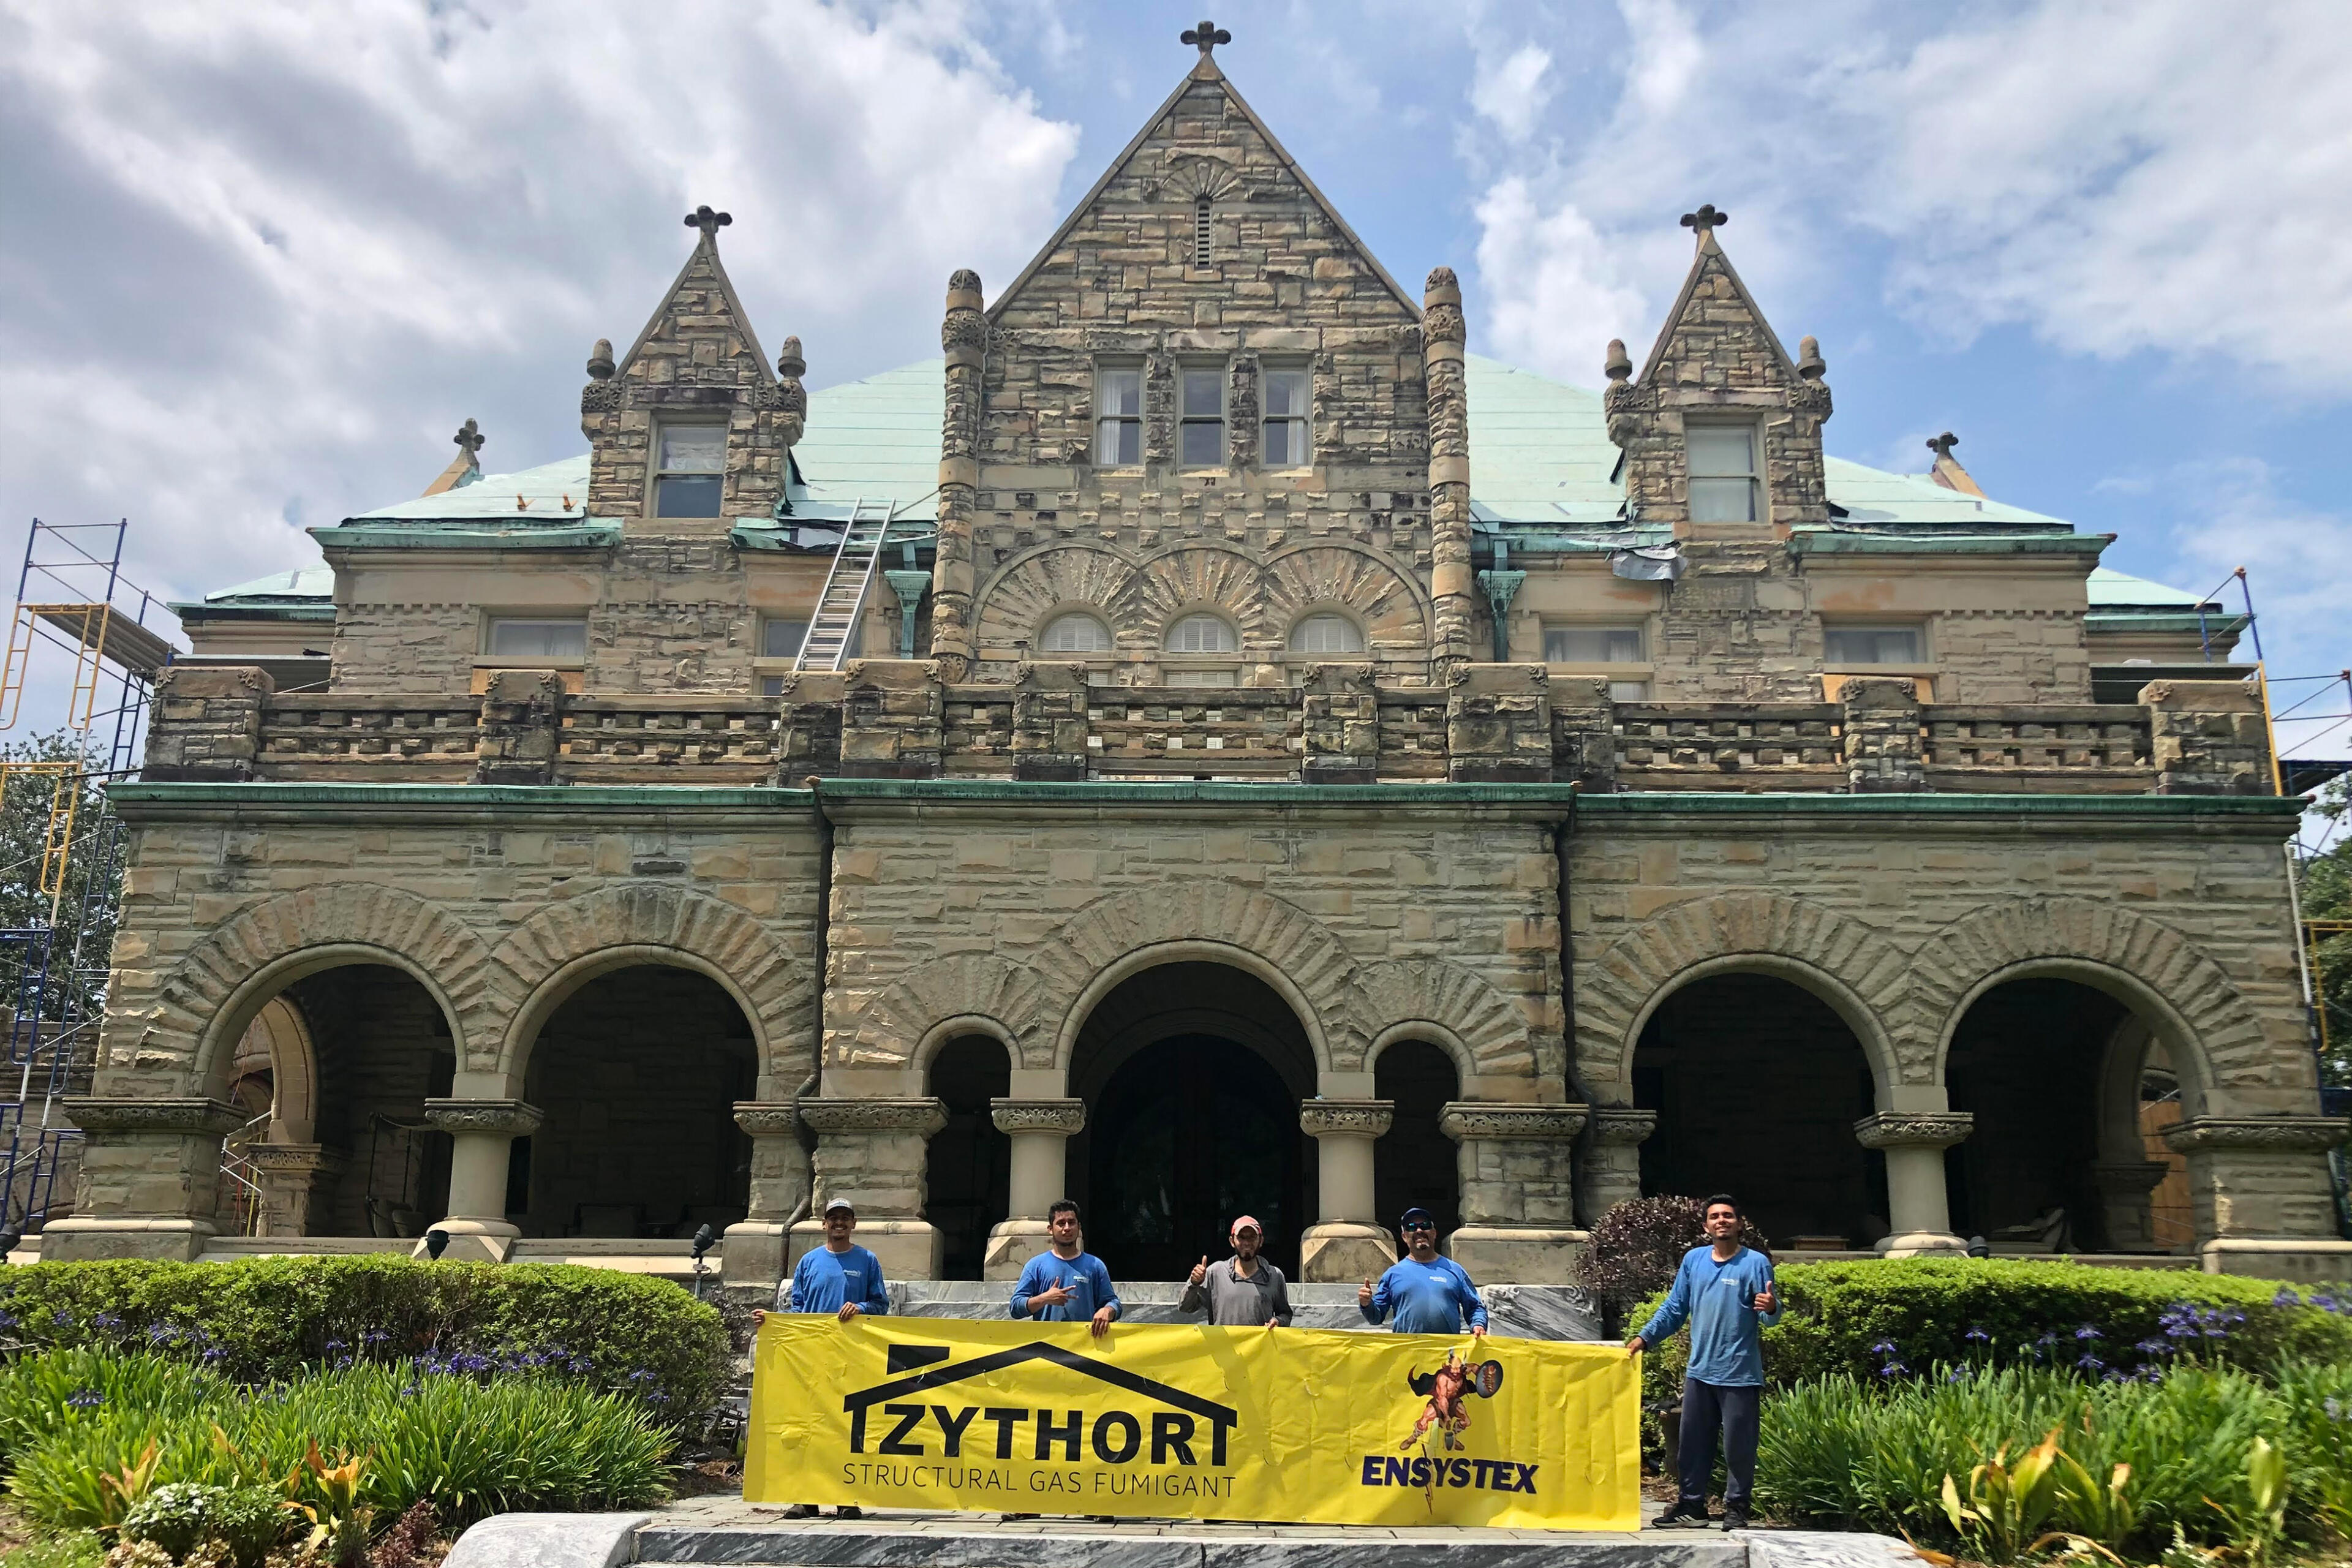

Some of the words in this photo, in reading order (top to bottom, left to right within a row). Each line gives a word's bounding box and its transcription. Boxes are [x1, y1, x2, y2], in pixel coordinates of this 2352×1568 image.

[878, 1403, 1198, 1466] ZYTHOR
[843, 1463, 1018, 1491] STRUCTURAL
[1030, 1470, 1082, 1493] GAS
[1095, 1472, 1236, 1498] FUMIGANT
[1361, 1455, 1540, 1494] ENSYSTEX
